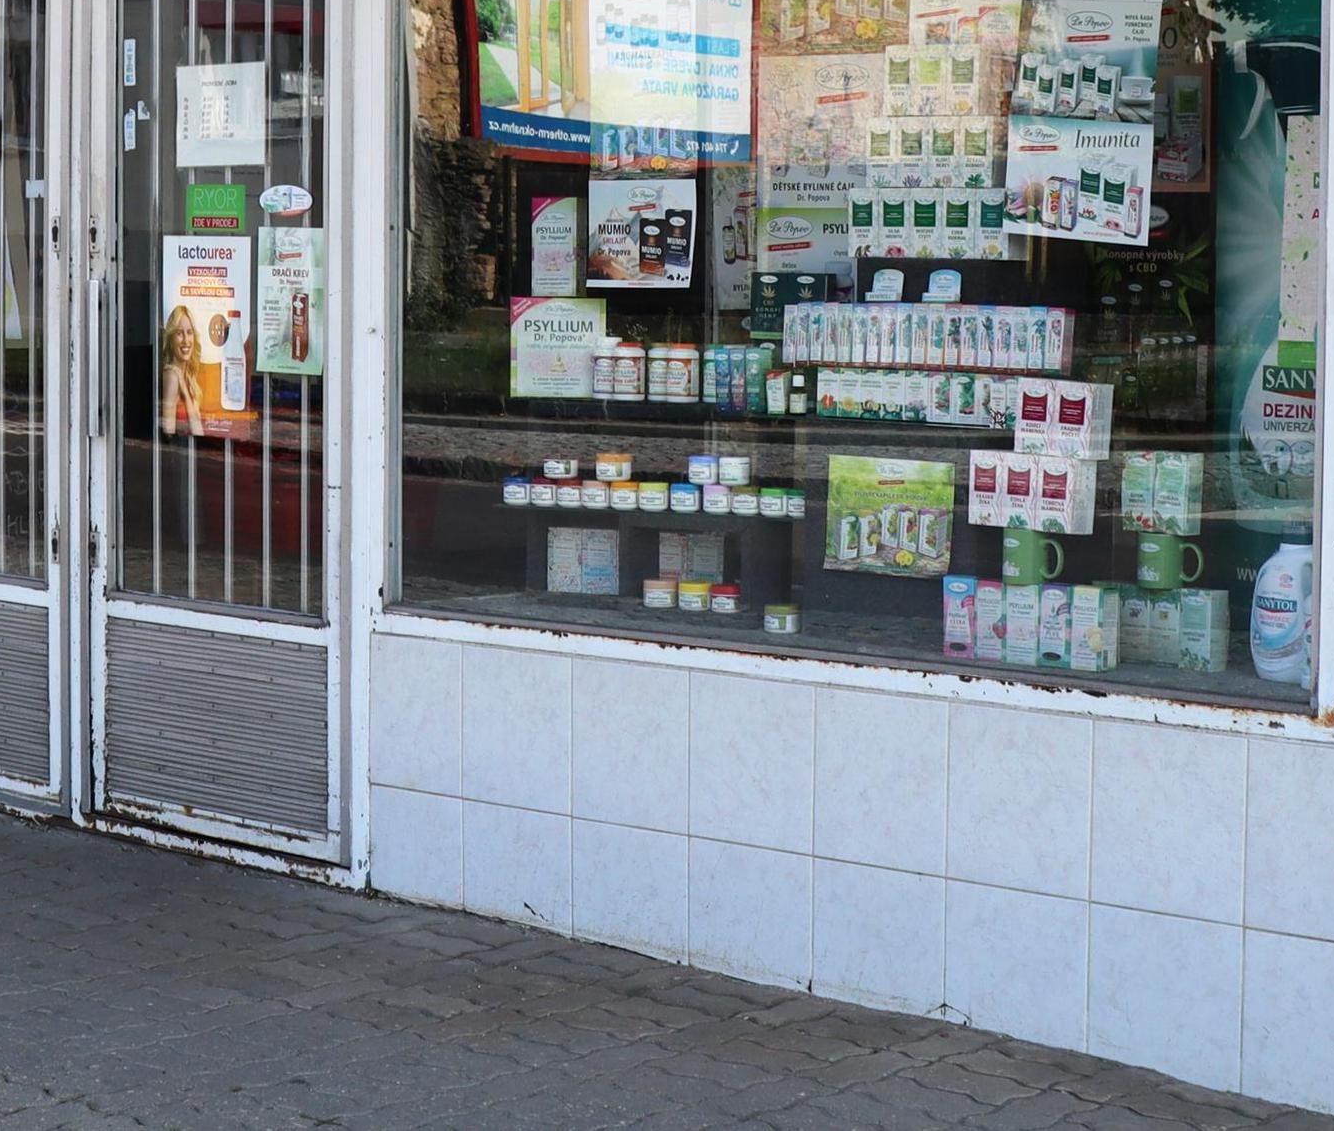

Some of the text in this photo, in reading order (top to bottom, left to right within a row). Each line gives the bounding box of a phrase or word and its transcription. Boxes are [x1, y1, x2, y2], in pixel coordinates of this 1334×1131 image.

[1087, 14, 1111, 30] Popov
[1075, 129, 1141, 149] Imunita
[773, 181, 801, 192] DĚTSKÉ
[803, 181, 835, 191] BYLINNÉ
[194, 189, 237, 208] RYOR
[797, 194, 830, 203] Dr. Popova
[193, 219, 205, 227] ZDE
[212, 219, 237, 228] PRODEJI
[786, 219, 810, 235] Popov
[536, 226, 572, 234] PSYLLIUM
[598, 224, 631, 235] MUMIO
[667, 236, 687, 247] MUMIO
[178, 245, 232, 260] lactourea
[598, 249, 631, 258] Dr. Popova
[642, 245, 662, 256] MUMIO
[1105, 248, 1184, 262] Konopné výrobky
[272, 267, 309, 278] DRAČÍ KREV
[1136, 263, 1157, 273] CBD
[524, 320, 594, 333] PSYLLIUM
[1257, 597, 1297, 611] SANYTOL
